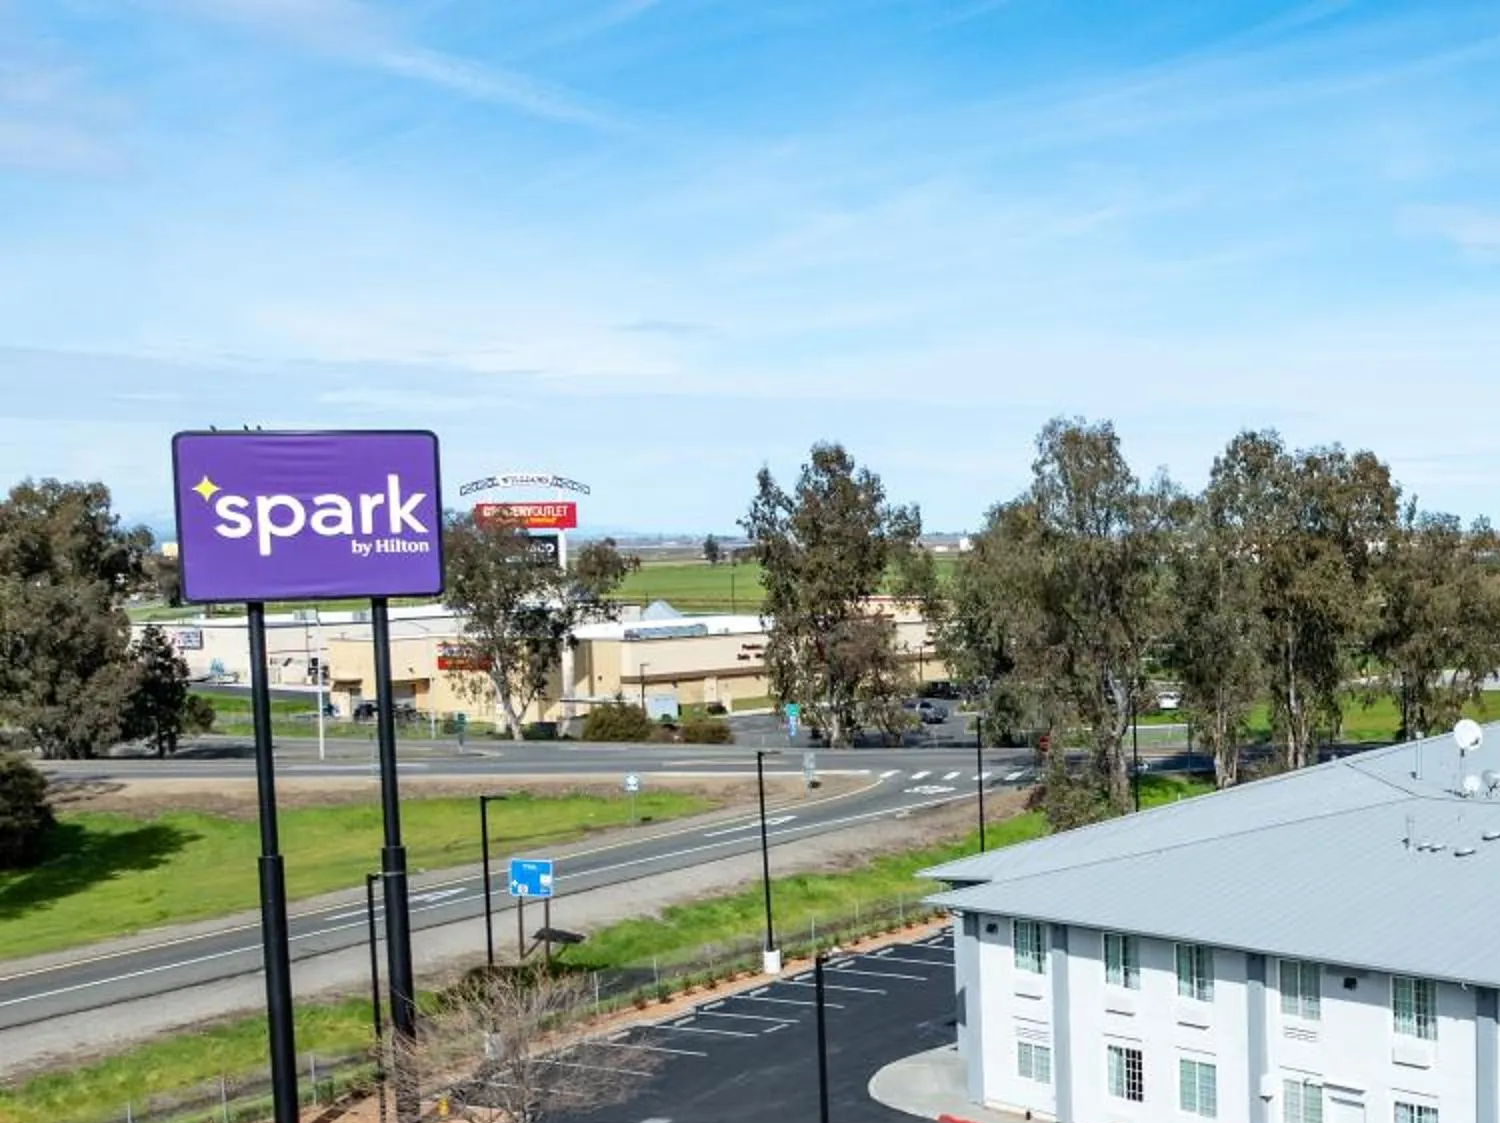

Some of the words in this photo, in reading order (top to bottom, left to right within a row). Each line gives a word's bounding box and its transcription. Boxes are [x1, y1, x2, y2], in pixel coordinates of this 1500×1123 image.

[214, 474, 430, 557] spark
[351, 540, 372, 557] by
[375, 538, 430, 553] Hilton
